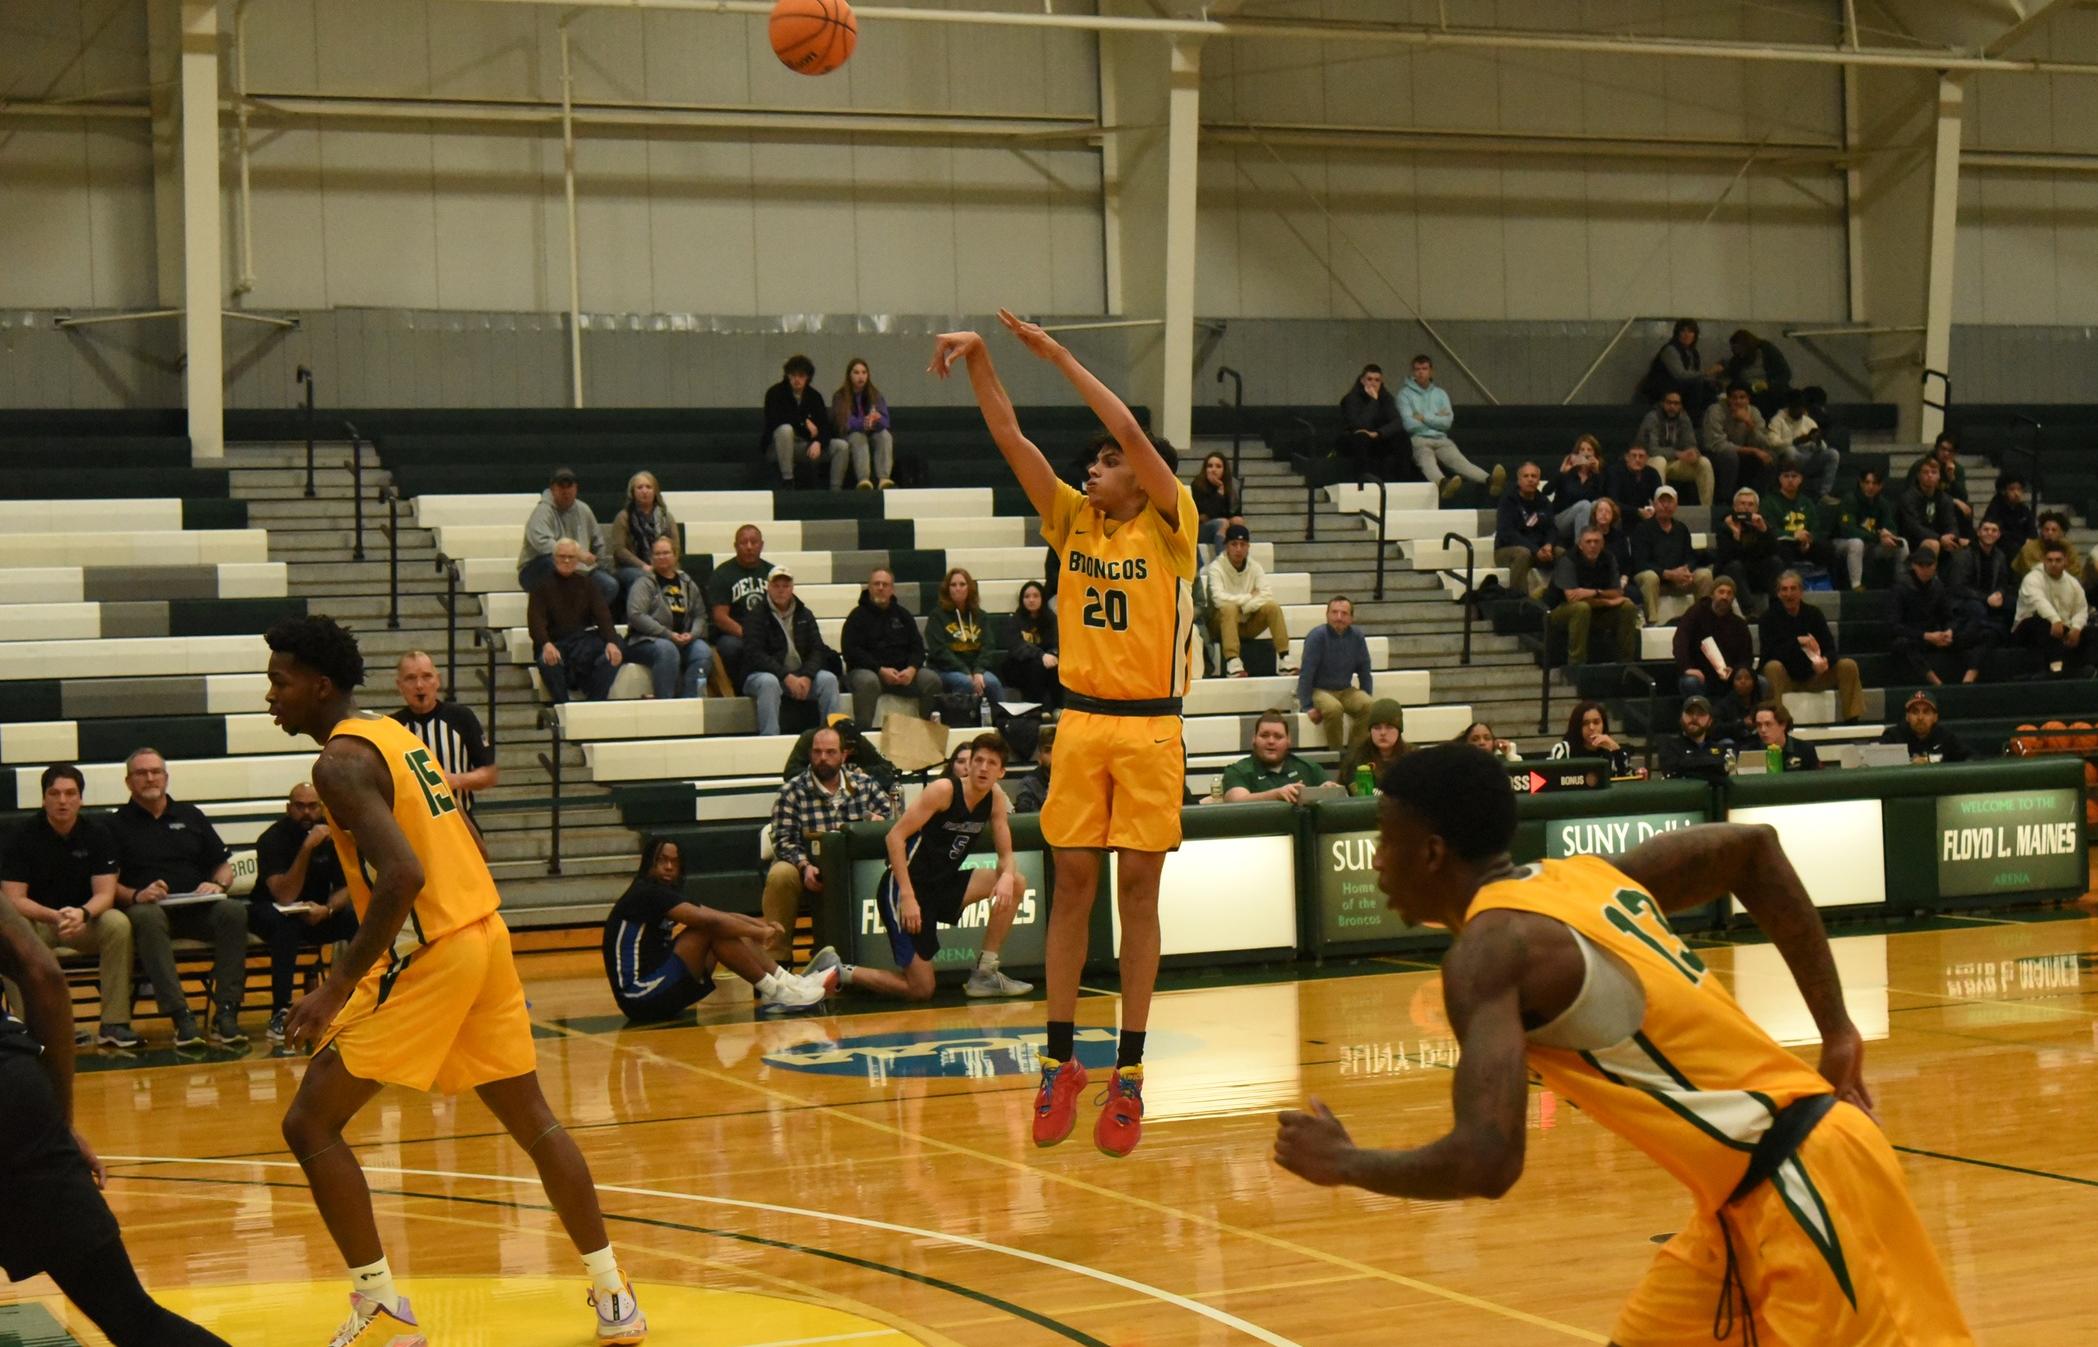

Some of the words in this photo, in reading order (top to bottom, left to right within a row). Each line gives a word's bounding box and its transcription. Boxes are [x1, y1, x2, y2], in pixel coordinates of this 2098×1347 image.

[1068, 549, 1149, 581] BRONCOS
[731, 576, 769, 603] DELH
[1082, 585, 1129, 632] 20
[403, 748, 457, 819] 15
[1510, 775, 1530, 791] SS
[1560, 775, 1585, 787] BONUS
[1961, 799, 2014, 814] WELCOME
[2019, 799, 2034, 811] TO
[2036, 796, 2057, 809] THE
[1562, 822, 1630, 856] SUNY
[1943, 827, 1994, 862] FLOYD
[1997, 826, 2012, 858] L.
[2016, 822, 2077, 857] MAINES
[1332, 838, 1377, 872] SUN
[1342, 882, 1376, 894] Home
[1993, 873, 2030, 886] ARENA
[1342, 898, 1355, 911] of
[1359, 897, 1377, 909] the
[1338, 914, 1382, 927] Broncos
[937, 948, 976, 962] RENA
